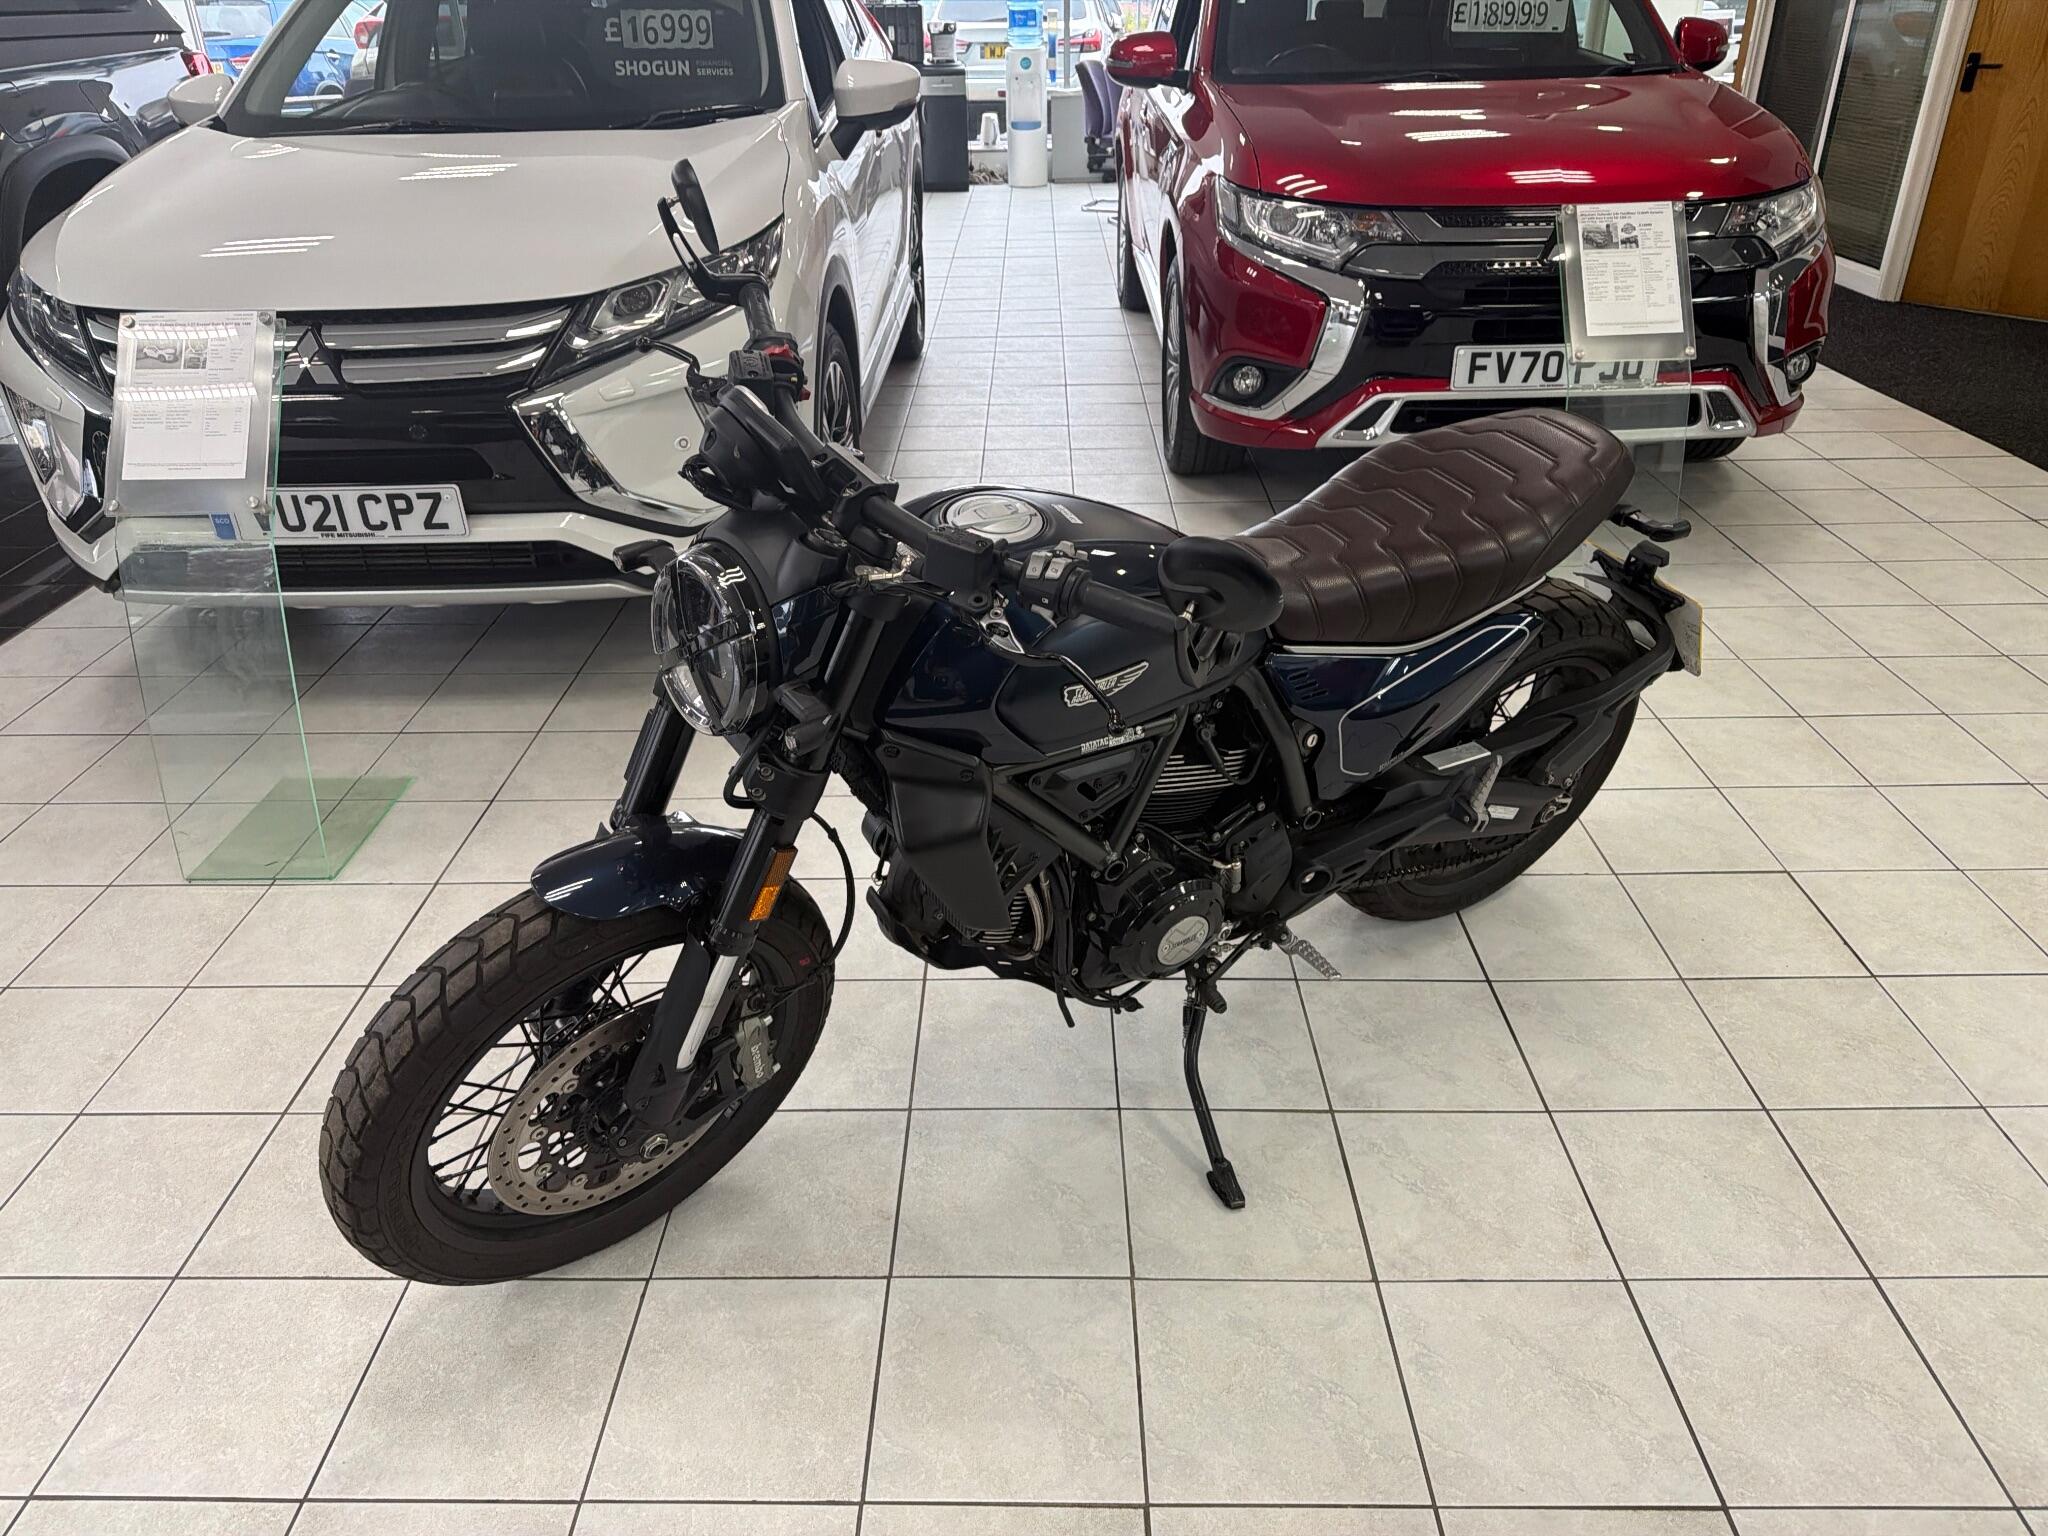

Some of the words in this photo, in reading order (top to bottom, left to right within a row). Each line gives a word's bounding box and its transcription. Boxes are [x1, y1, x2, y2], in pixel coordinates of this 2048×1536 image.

[1453, 1, 1549, 27] £18999
[604, 13, 711, 46] £16999
[614, 59, 691, 77] SHOGUN
[696, 67, 734, 76] SERVICES
[1467, 350, 1565, 385] FV70
[356, 492, 450, 532] CPZ
[336, 531, 376, 539] MITSUBISHI
[751, 1042, 765, 1079] brembo
